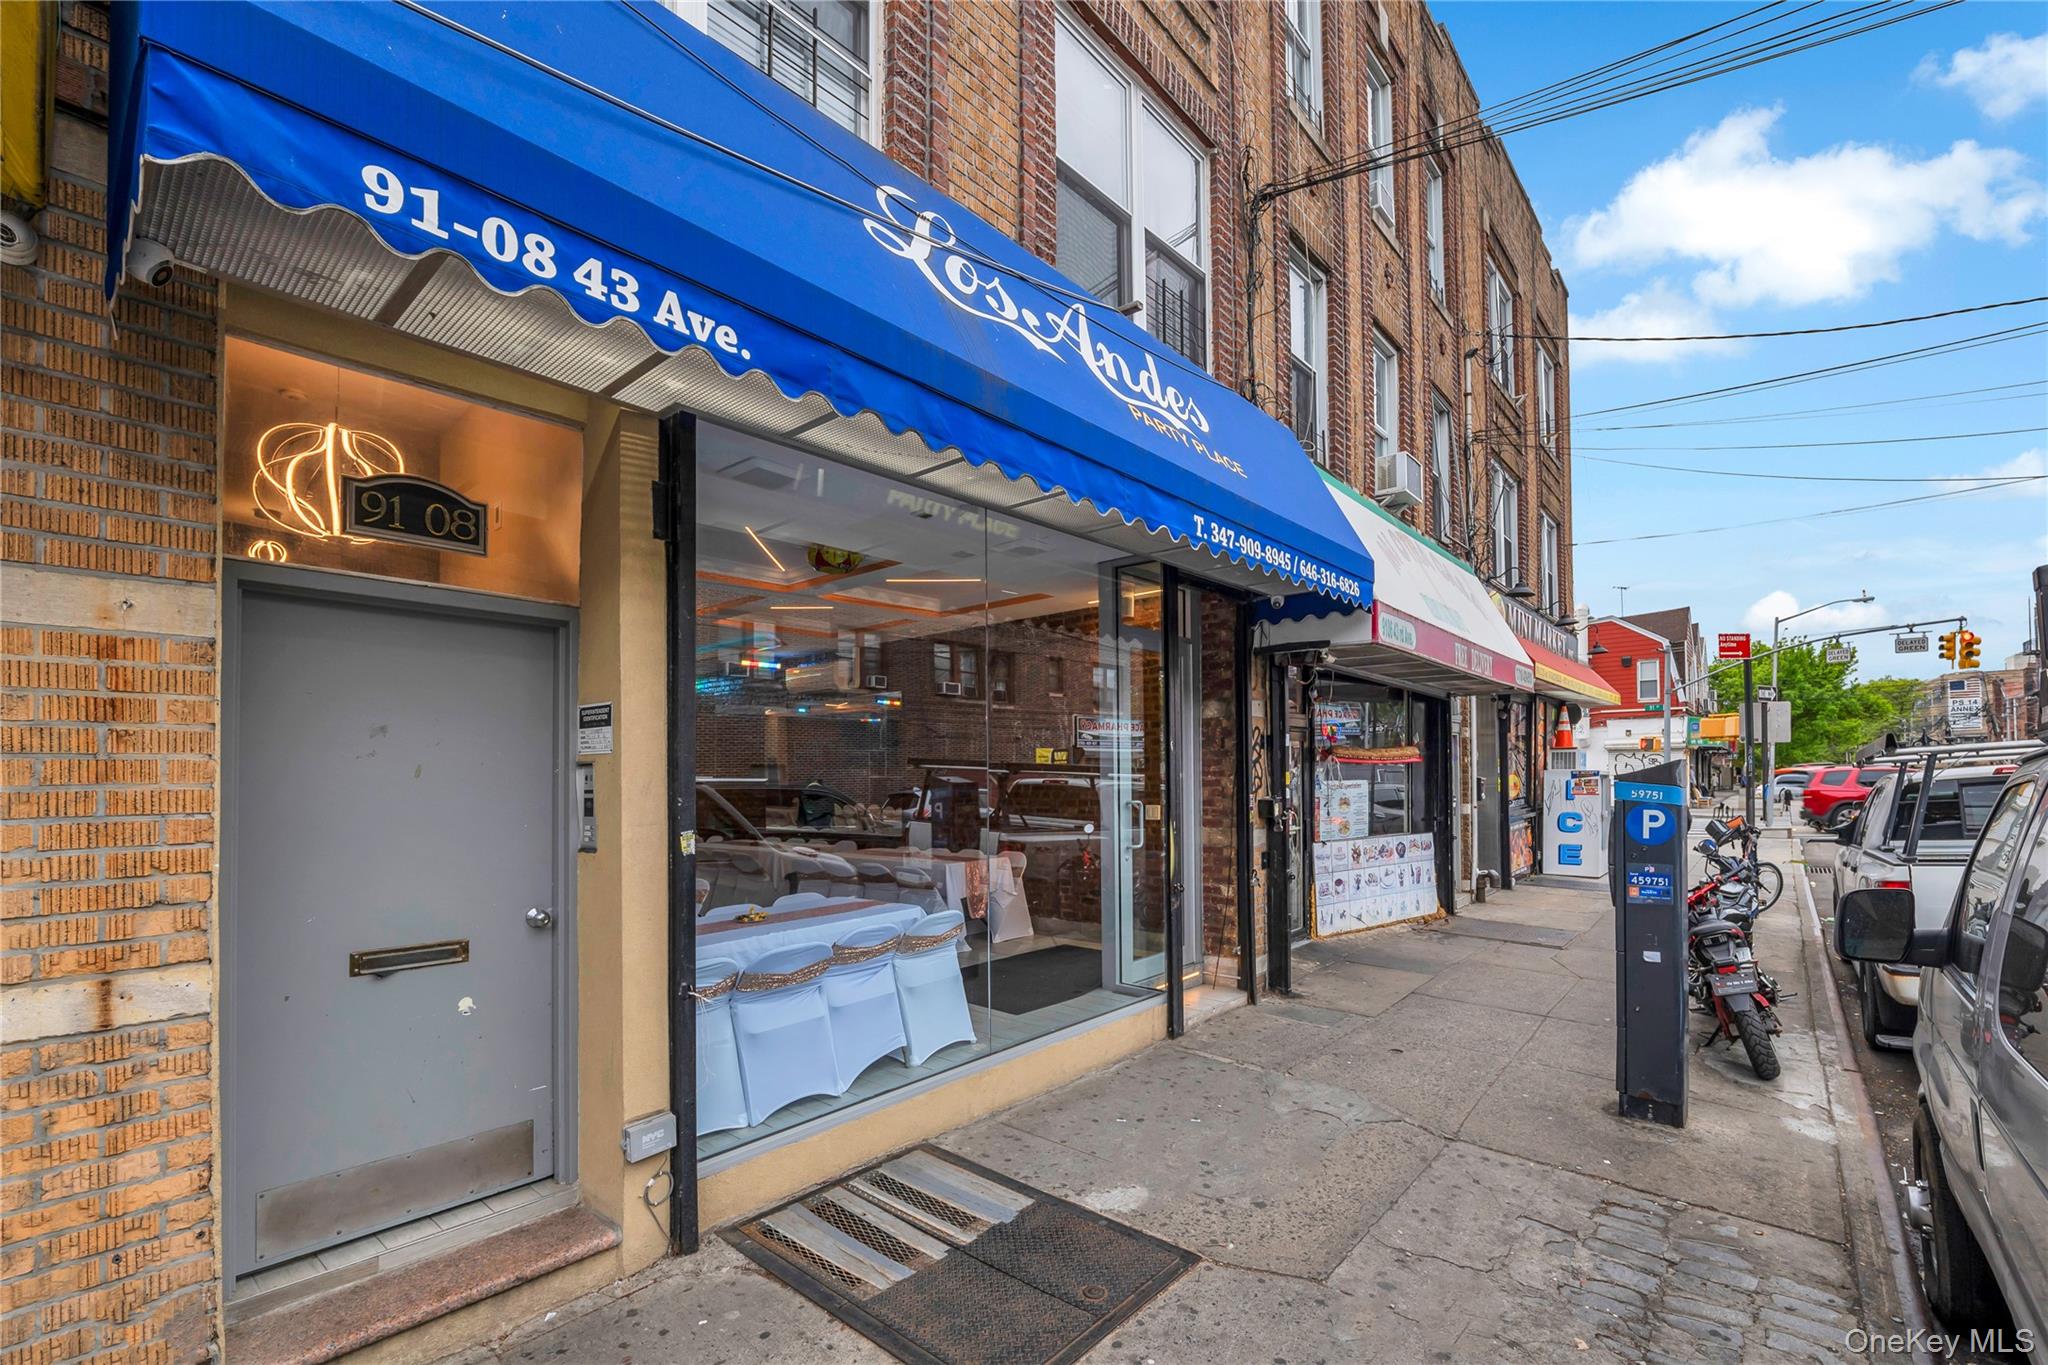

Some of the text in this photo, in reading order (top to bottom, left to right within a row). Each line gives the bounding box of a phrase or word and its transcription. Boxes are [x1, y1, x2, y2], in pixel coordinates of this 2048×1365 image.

[361, 164, 752, 360] 91-08 43 Ave.
[1021, 303, 1210, 438] Andes
[1127, 403, 1249, 479] PARTY PLACE
[360, 490, 478, 540] 91 08
[1193, 514, 1208, 540] T.
[1210, 522, 1292, 571] 347-909-8945
[1299, 560, 1360, 598] 646-316-6826
[1506, 603, 1532, 642] MINI
[1534, 618, 1567, 659] MARKET
[1454, 642, 1468, 669] FREE
[1471, 648, 1493, 677] DELIVERY
[1642, 809, 1666, 839] P
[1631, 876, 1669, 886] 459751
